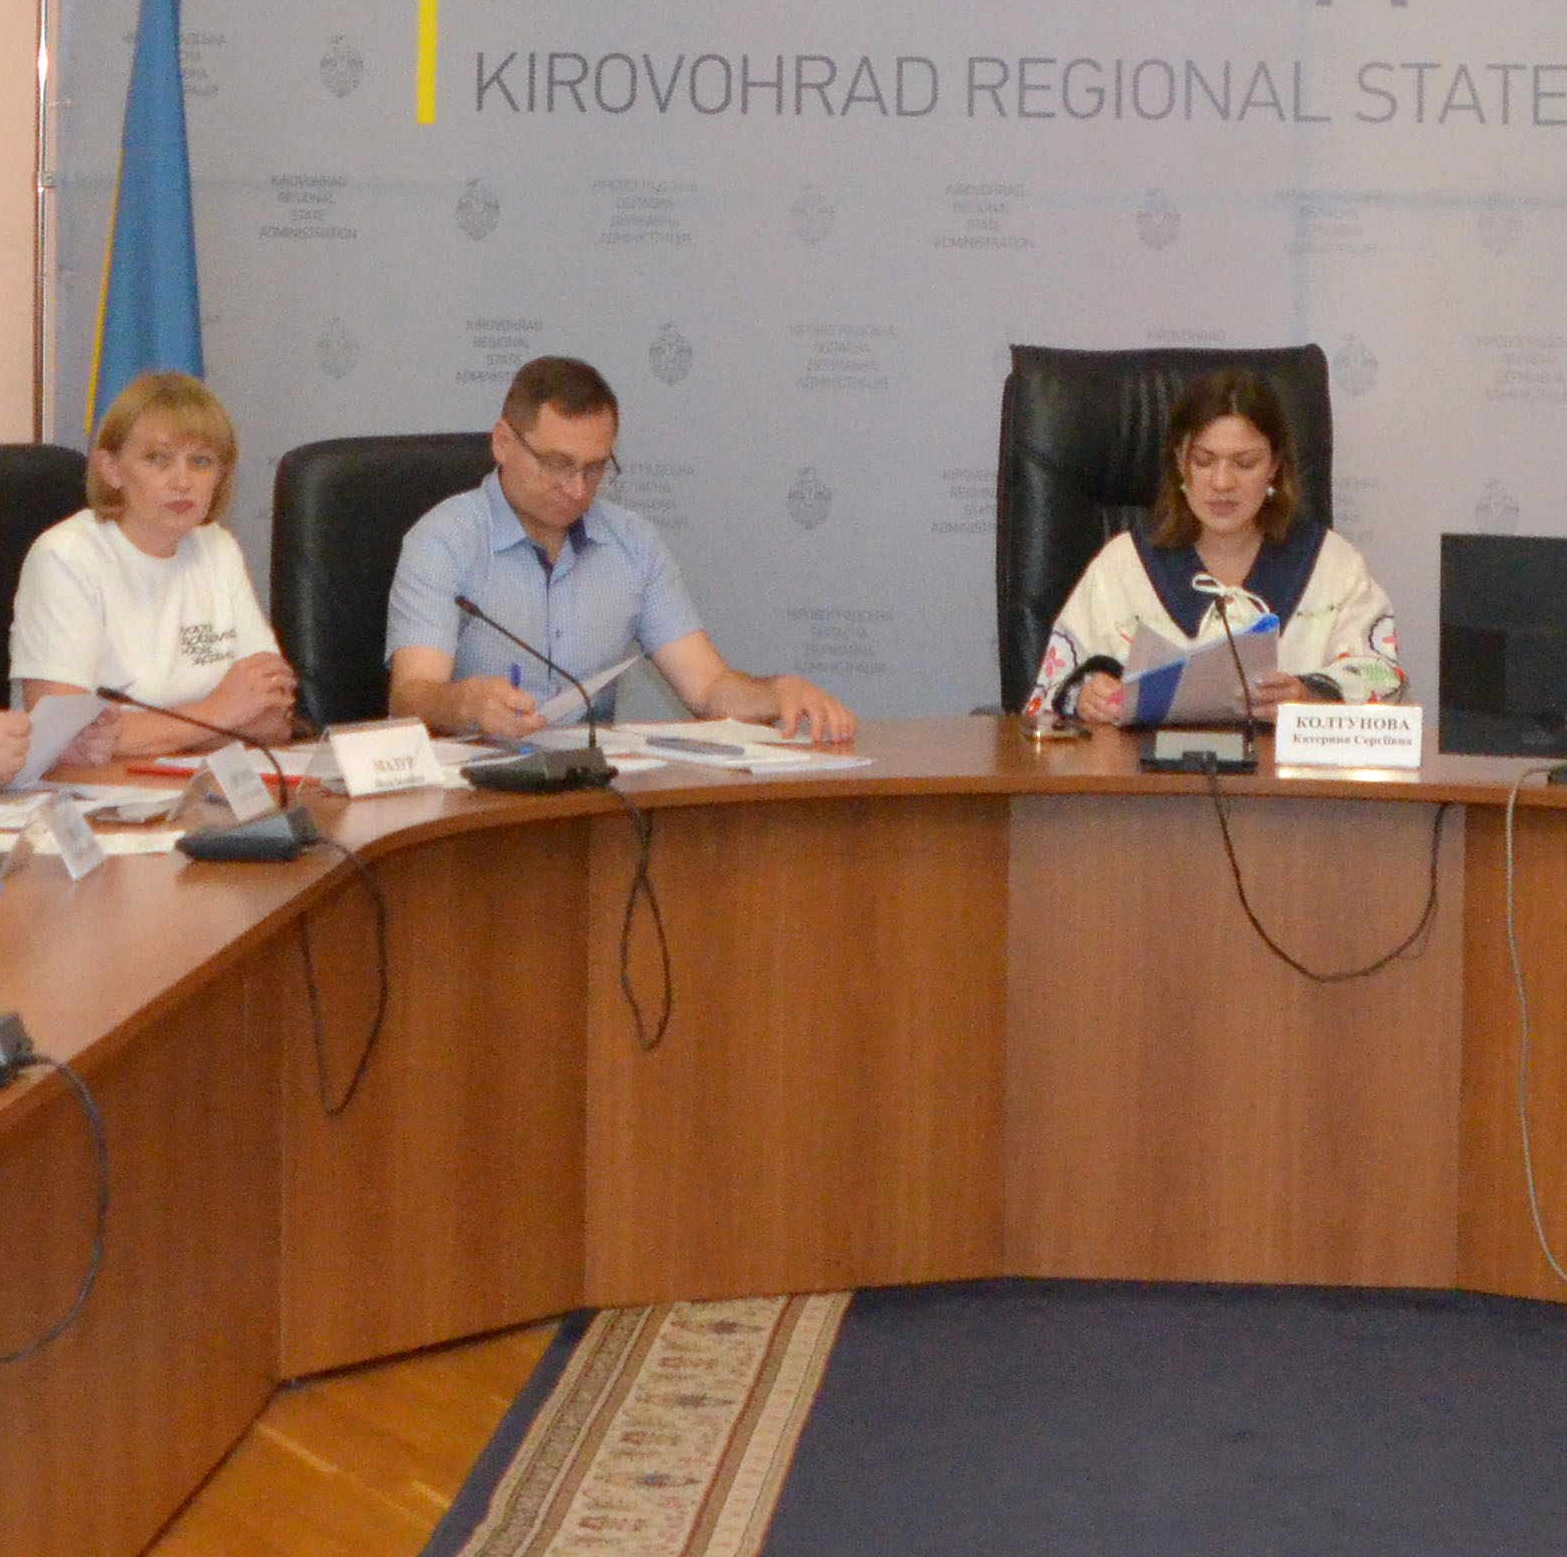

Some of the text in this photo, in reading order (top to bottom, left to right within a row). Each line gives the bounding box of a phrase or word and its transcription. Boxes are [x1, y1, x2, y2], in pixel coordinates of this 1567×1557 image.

[475, 51, 939, 118] KIROVOHRAD
[966, 57, 1332, 123] REGIONAL
[1296, 716, 1410, 731] КОЛТУНОВА
